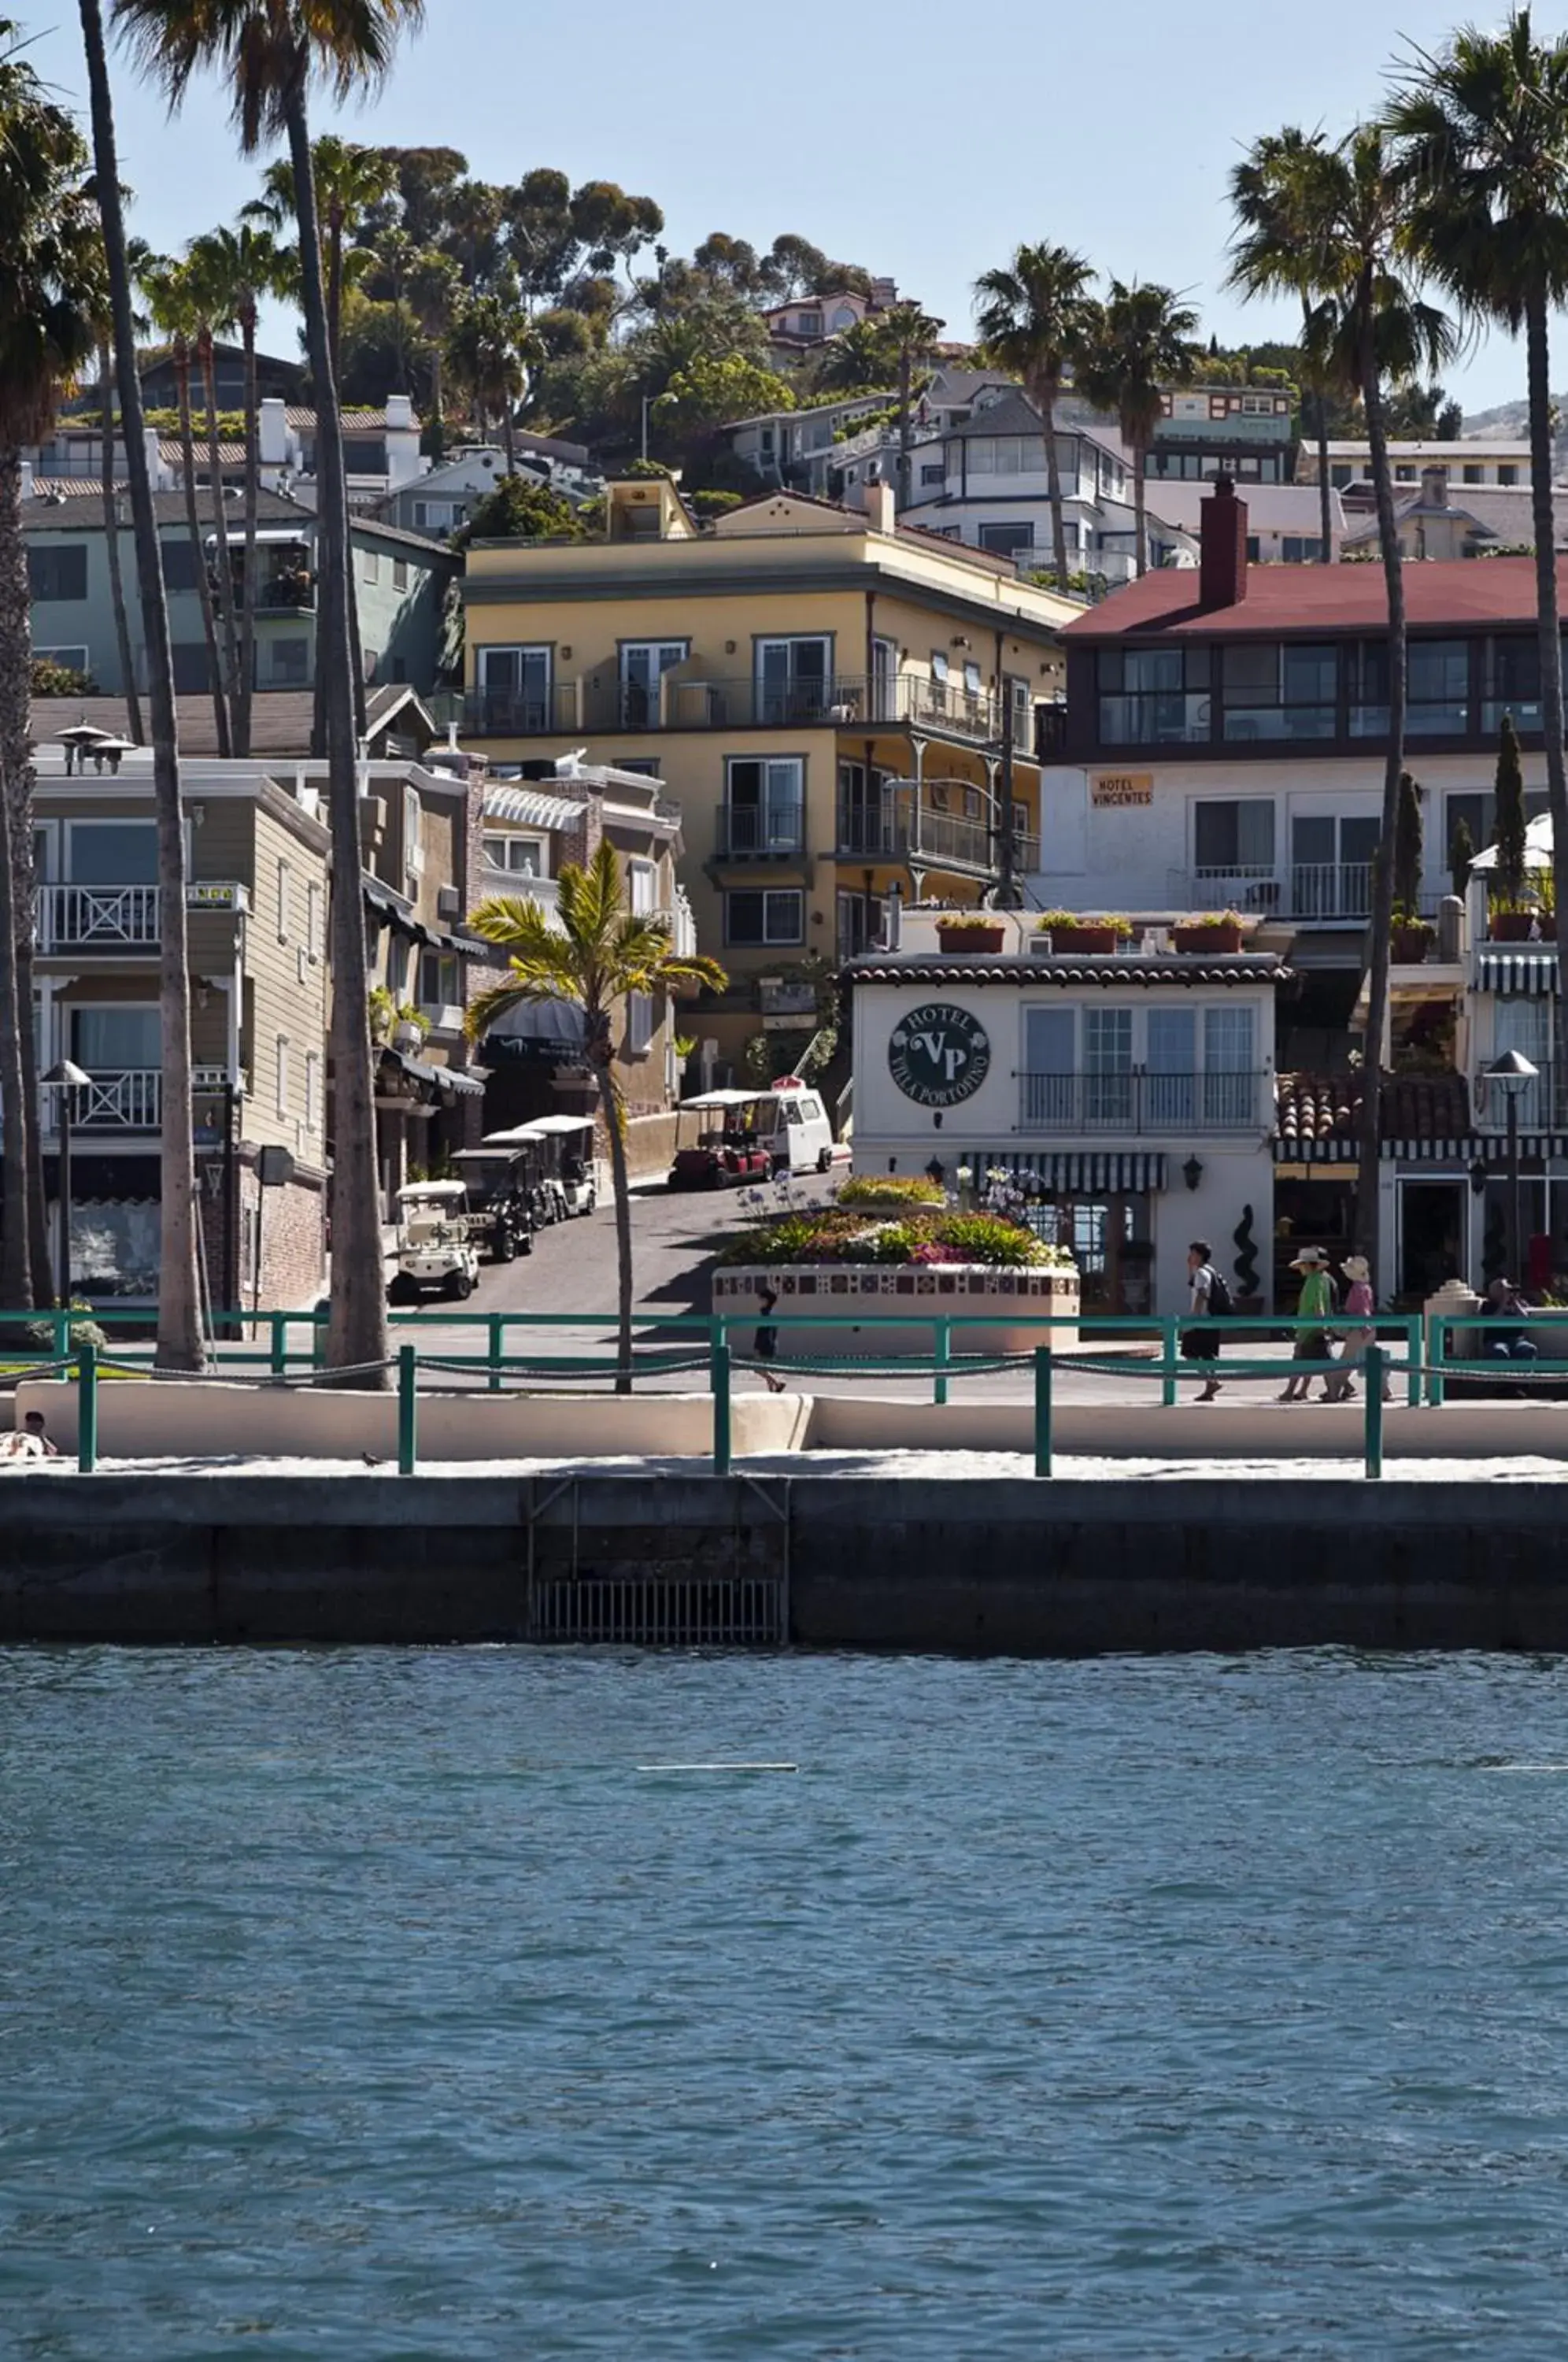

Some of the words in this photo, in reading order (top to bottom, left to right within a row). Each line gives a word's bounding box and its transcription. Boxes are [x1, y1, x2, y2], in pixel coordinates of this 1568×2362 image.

[1099, 779, 1133, 791] HOTEL
[906, 1008, 970, 1031] HOTEL
[909, 1031, 967, 1080] VP
[891, 1056, 919, 1097] VILLA
[919, 1056, 988, 1104] PORTOFINO
